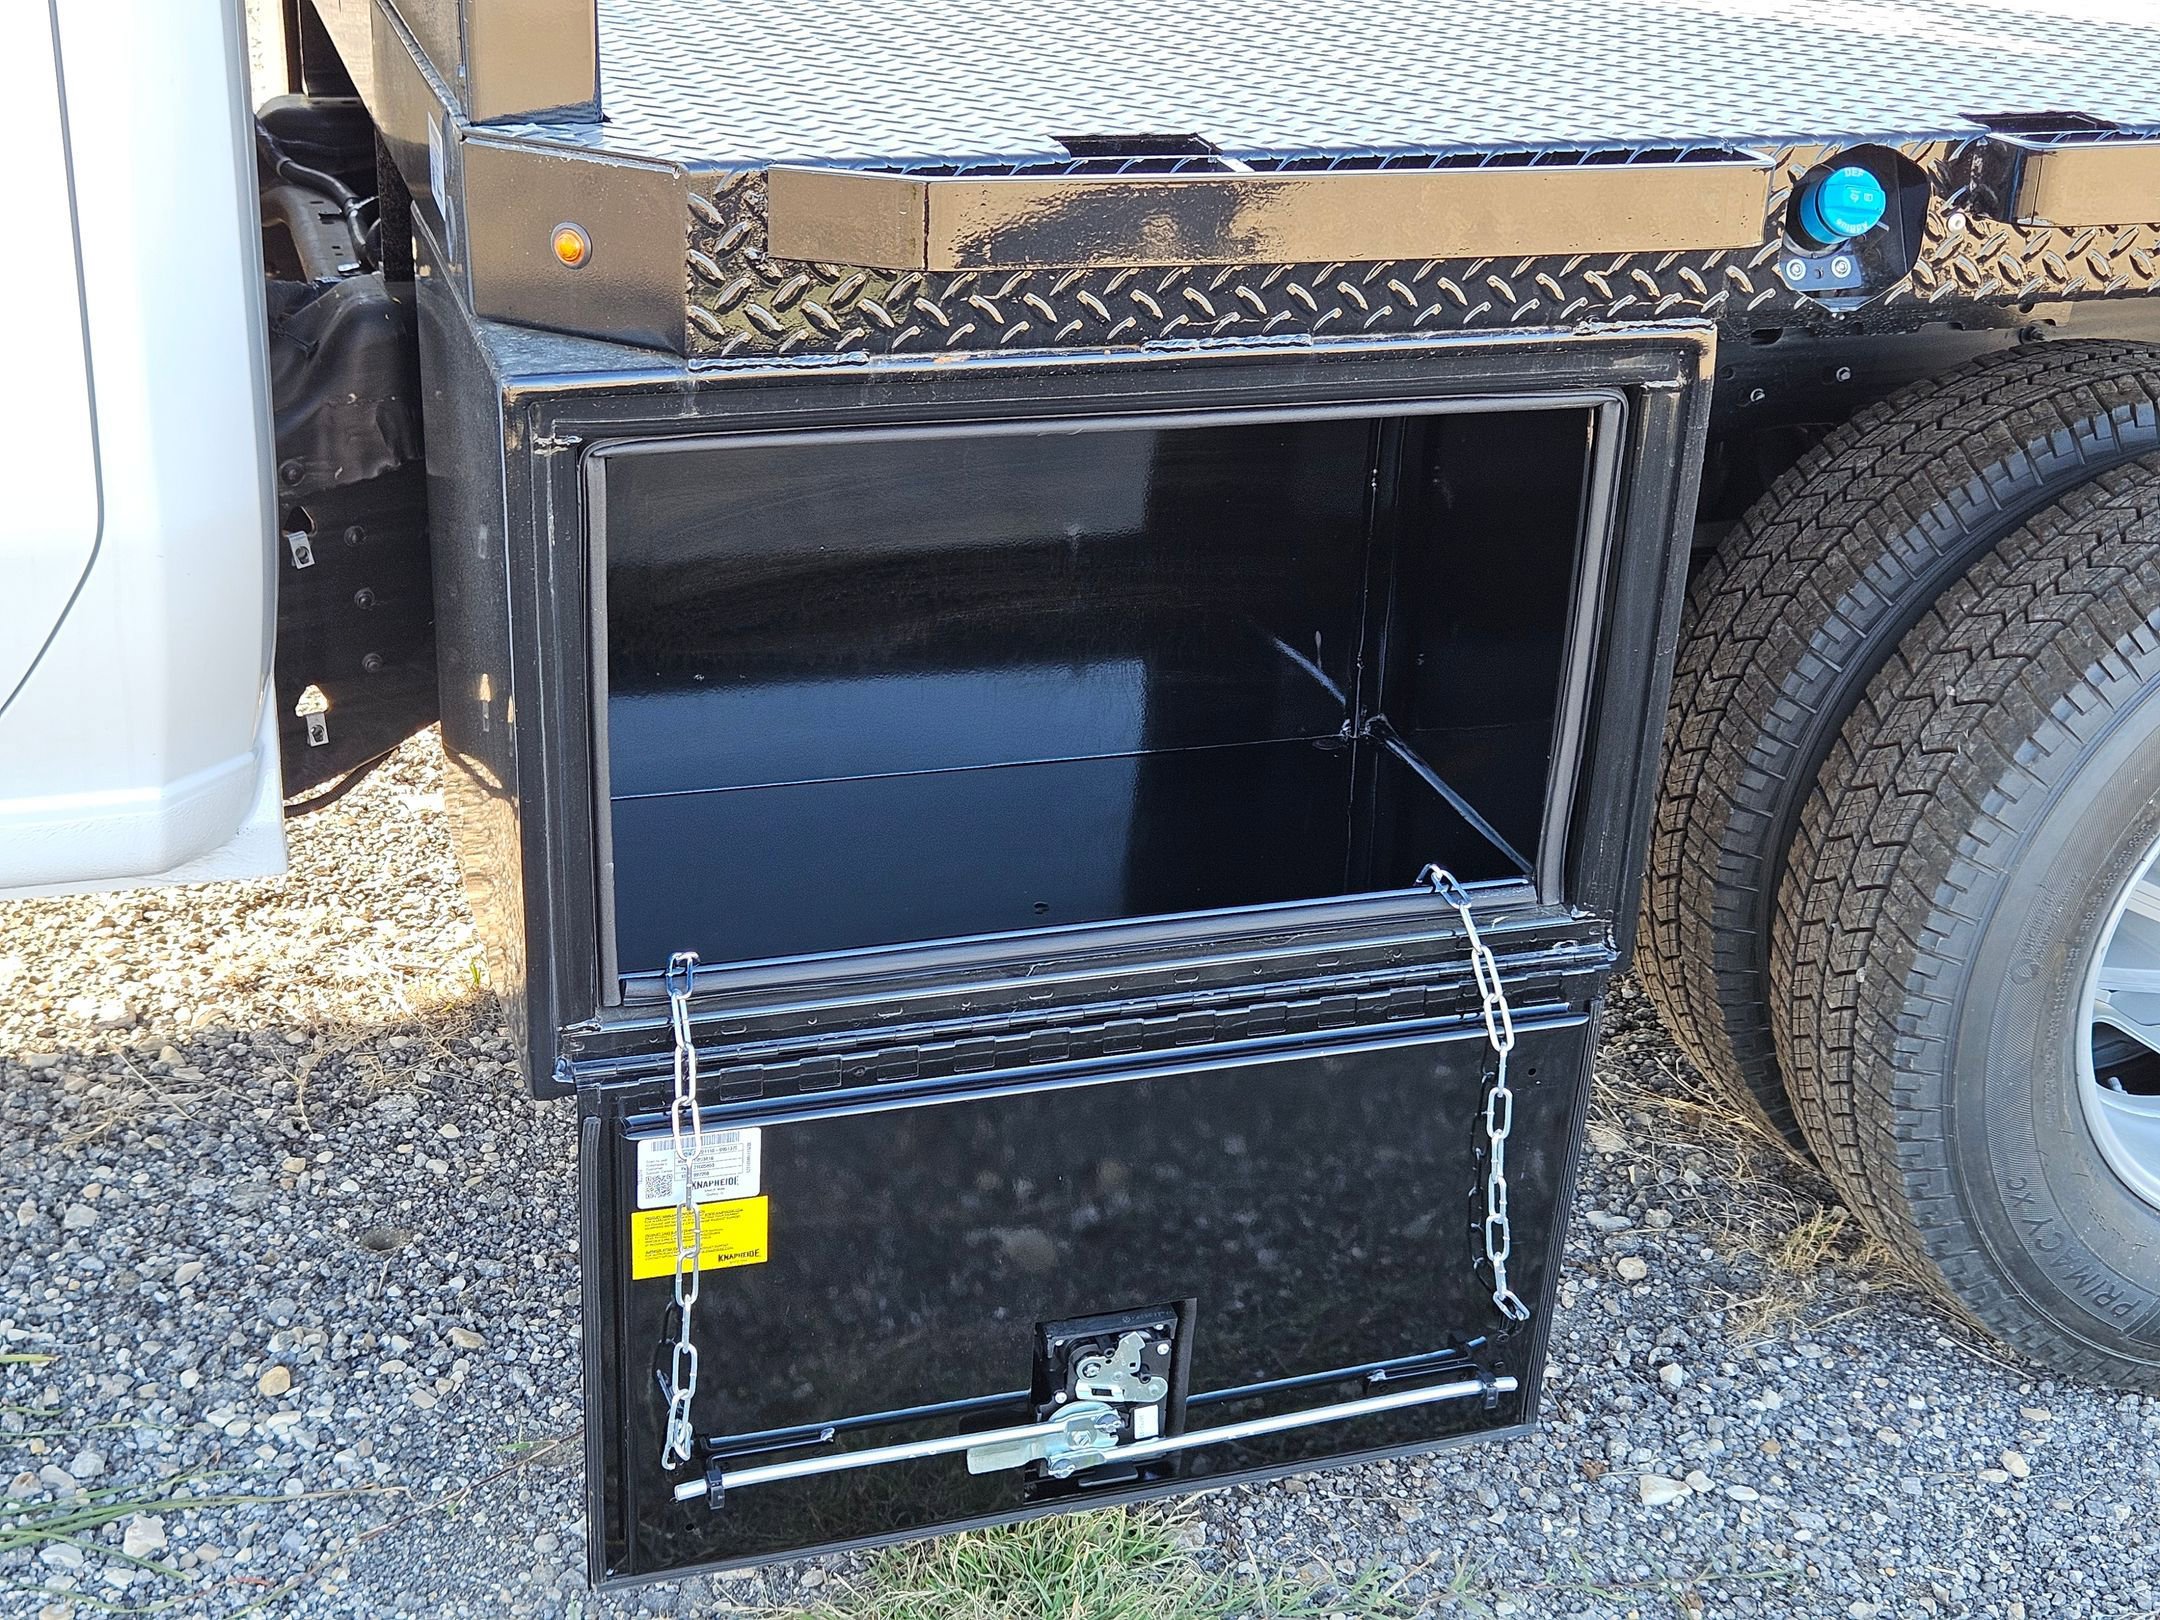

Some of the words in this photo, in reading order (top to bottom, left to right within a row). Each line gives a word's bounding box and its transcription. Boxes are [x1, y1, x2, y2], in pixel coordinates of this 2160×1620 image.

[1844, 168, 1864, 177] DEF
[2006, 1176, 2036, 1208] XC
[718, 1249, 760, 1262] KNAPHEIDE
[2022, 1217, 2141, 1317] PRIMACY
